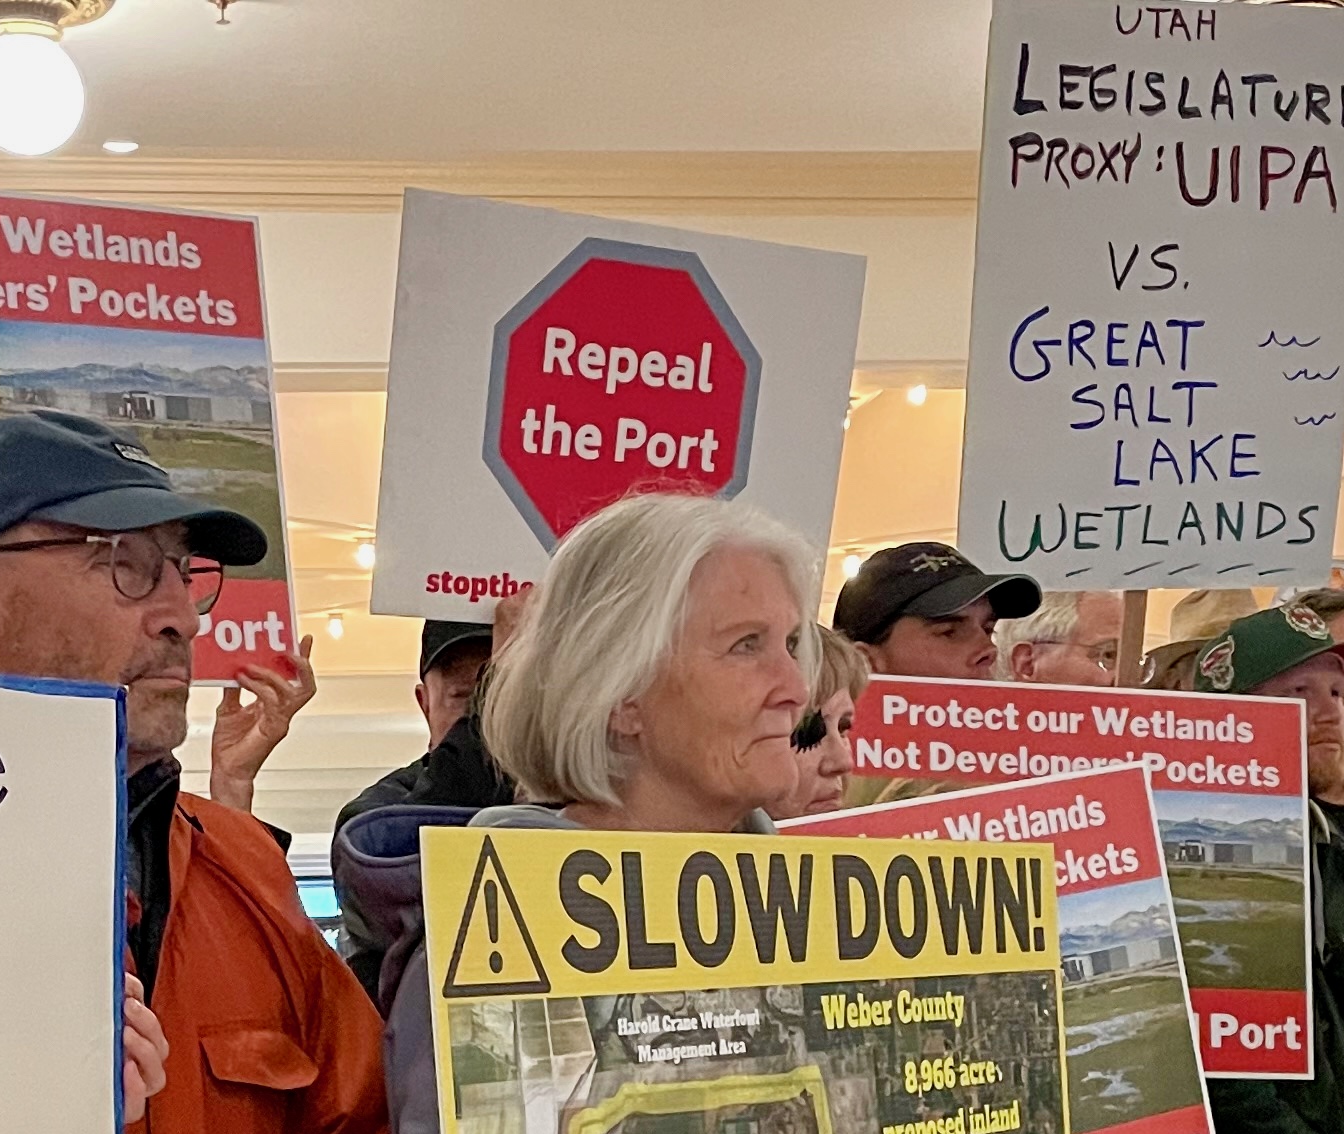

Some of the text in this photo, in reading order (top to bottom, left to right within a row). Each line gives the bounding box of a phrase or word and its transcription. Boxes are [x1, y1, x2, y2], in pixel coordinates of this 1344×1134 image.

[1116, 4, 1216, 40] UTAH
[1176, 141, 1337, 213] UIPA
[0, 215, 202, 270] Wetlands
[1108, 242, 1189, 291] VS.
[69, 278, 238, 327] Pockets
[543, 327, 713, 394] Repeal
[1010, 306, 1205, 382] GREAT
[1070, 381, 1217, 429] SALT
[521, 405, 719, 472] the Port
[1114, 434, 1260, 486] LAKE
[999, 500, 1319, 561] WETLANDS
[882, 695, 1254, 743] Protect our Wetlands
[856, 738, 921, 770] Not
[944, 800, 1106, 842] Wetlands
[1056, 843, 1139, 886] ckets
[558, 849, 1047, 974] SLOW DOWN!
[617, 1008, 760, 1035] Harold Crane Waterfowl
[821, 990, 965, 1031] Weber County
[1210, 1014, 1301, 1051] Port
[638, 1039, 746, 1065] Management Area
[904, 1060, 955, 1097] 8,966
[968, 1100, 1020, 1131] inland
